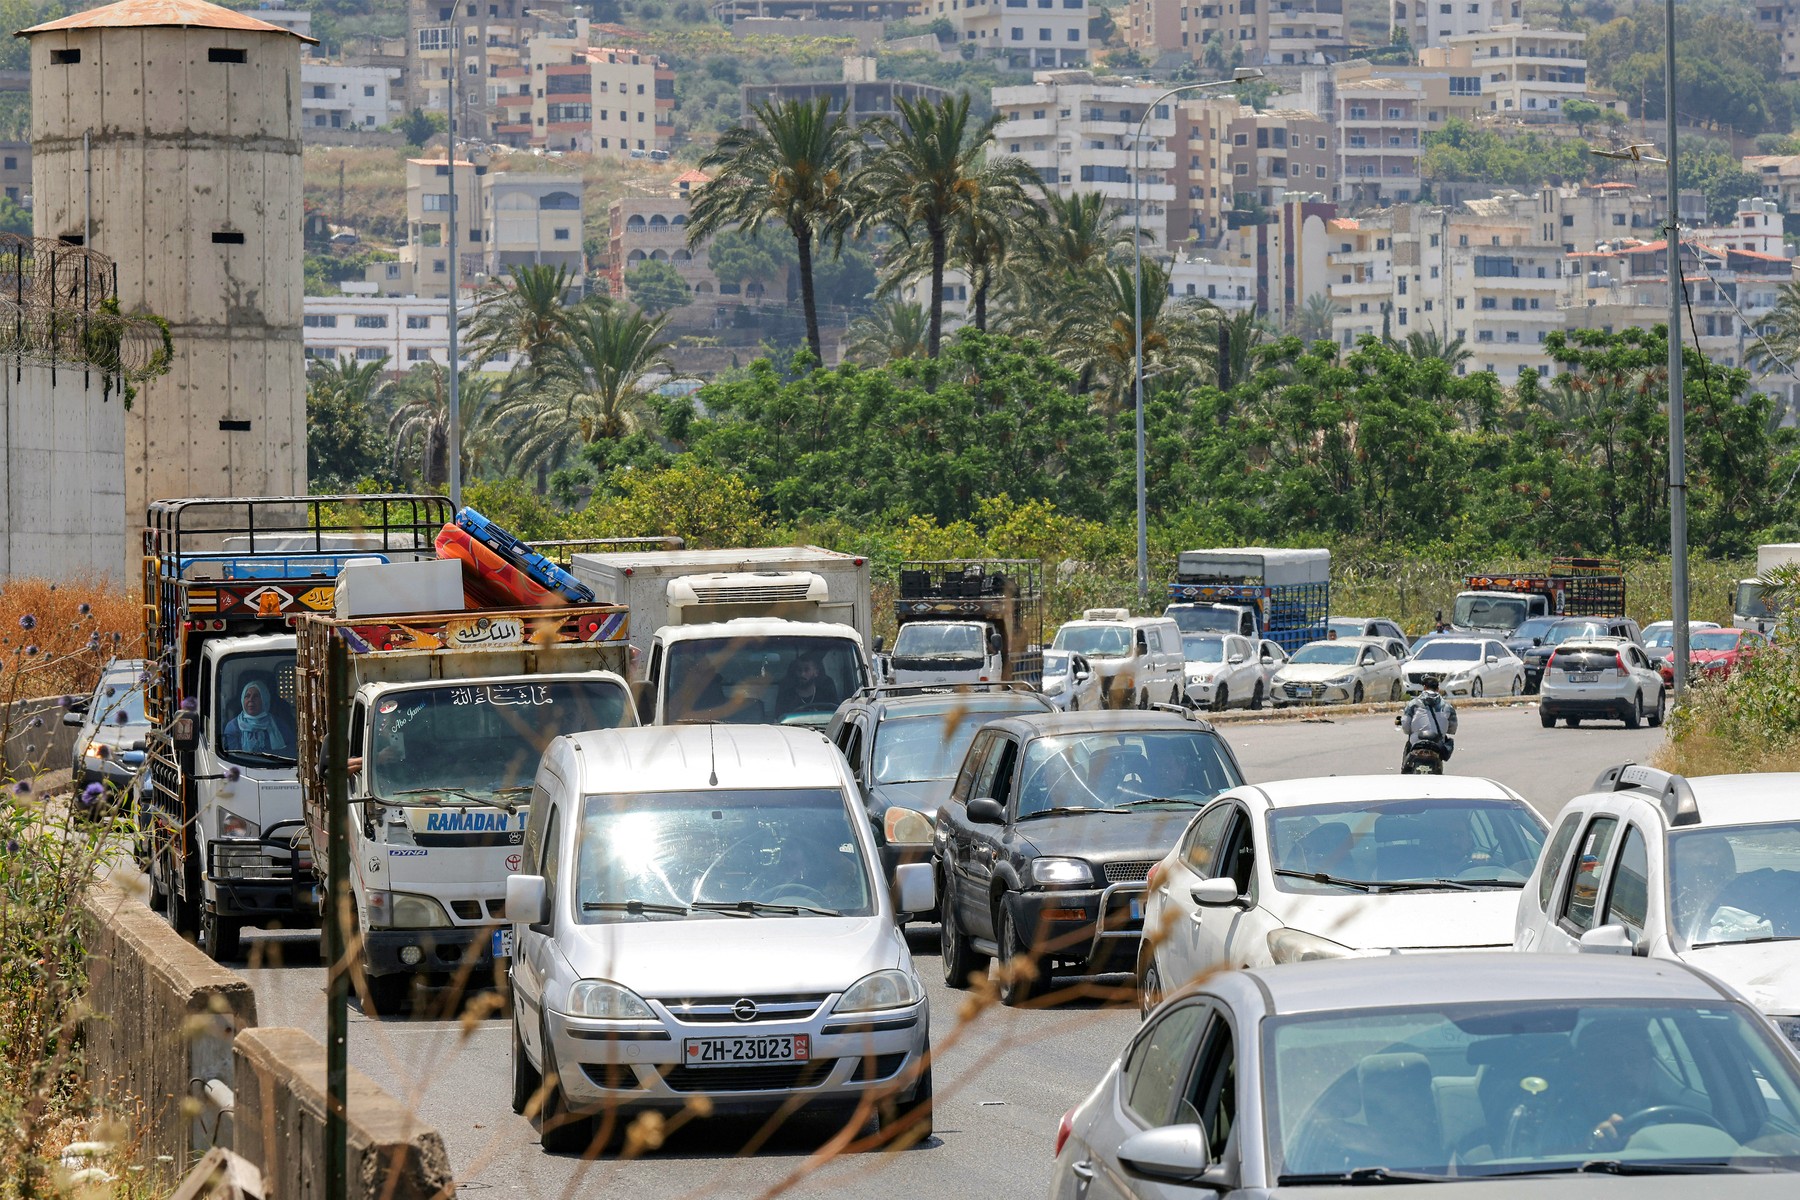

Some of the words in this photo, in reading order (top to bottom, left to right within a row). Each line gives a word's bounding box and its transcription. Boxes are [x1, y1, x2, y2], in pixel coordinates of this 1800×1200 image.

[427, 812, 508, 831] RAMADAN
[517, 811, 529, 830] T
[701, 1038, 792, 1061] ZH-23023
[796, 1040, 806, 1056] 02
